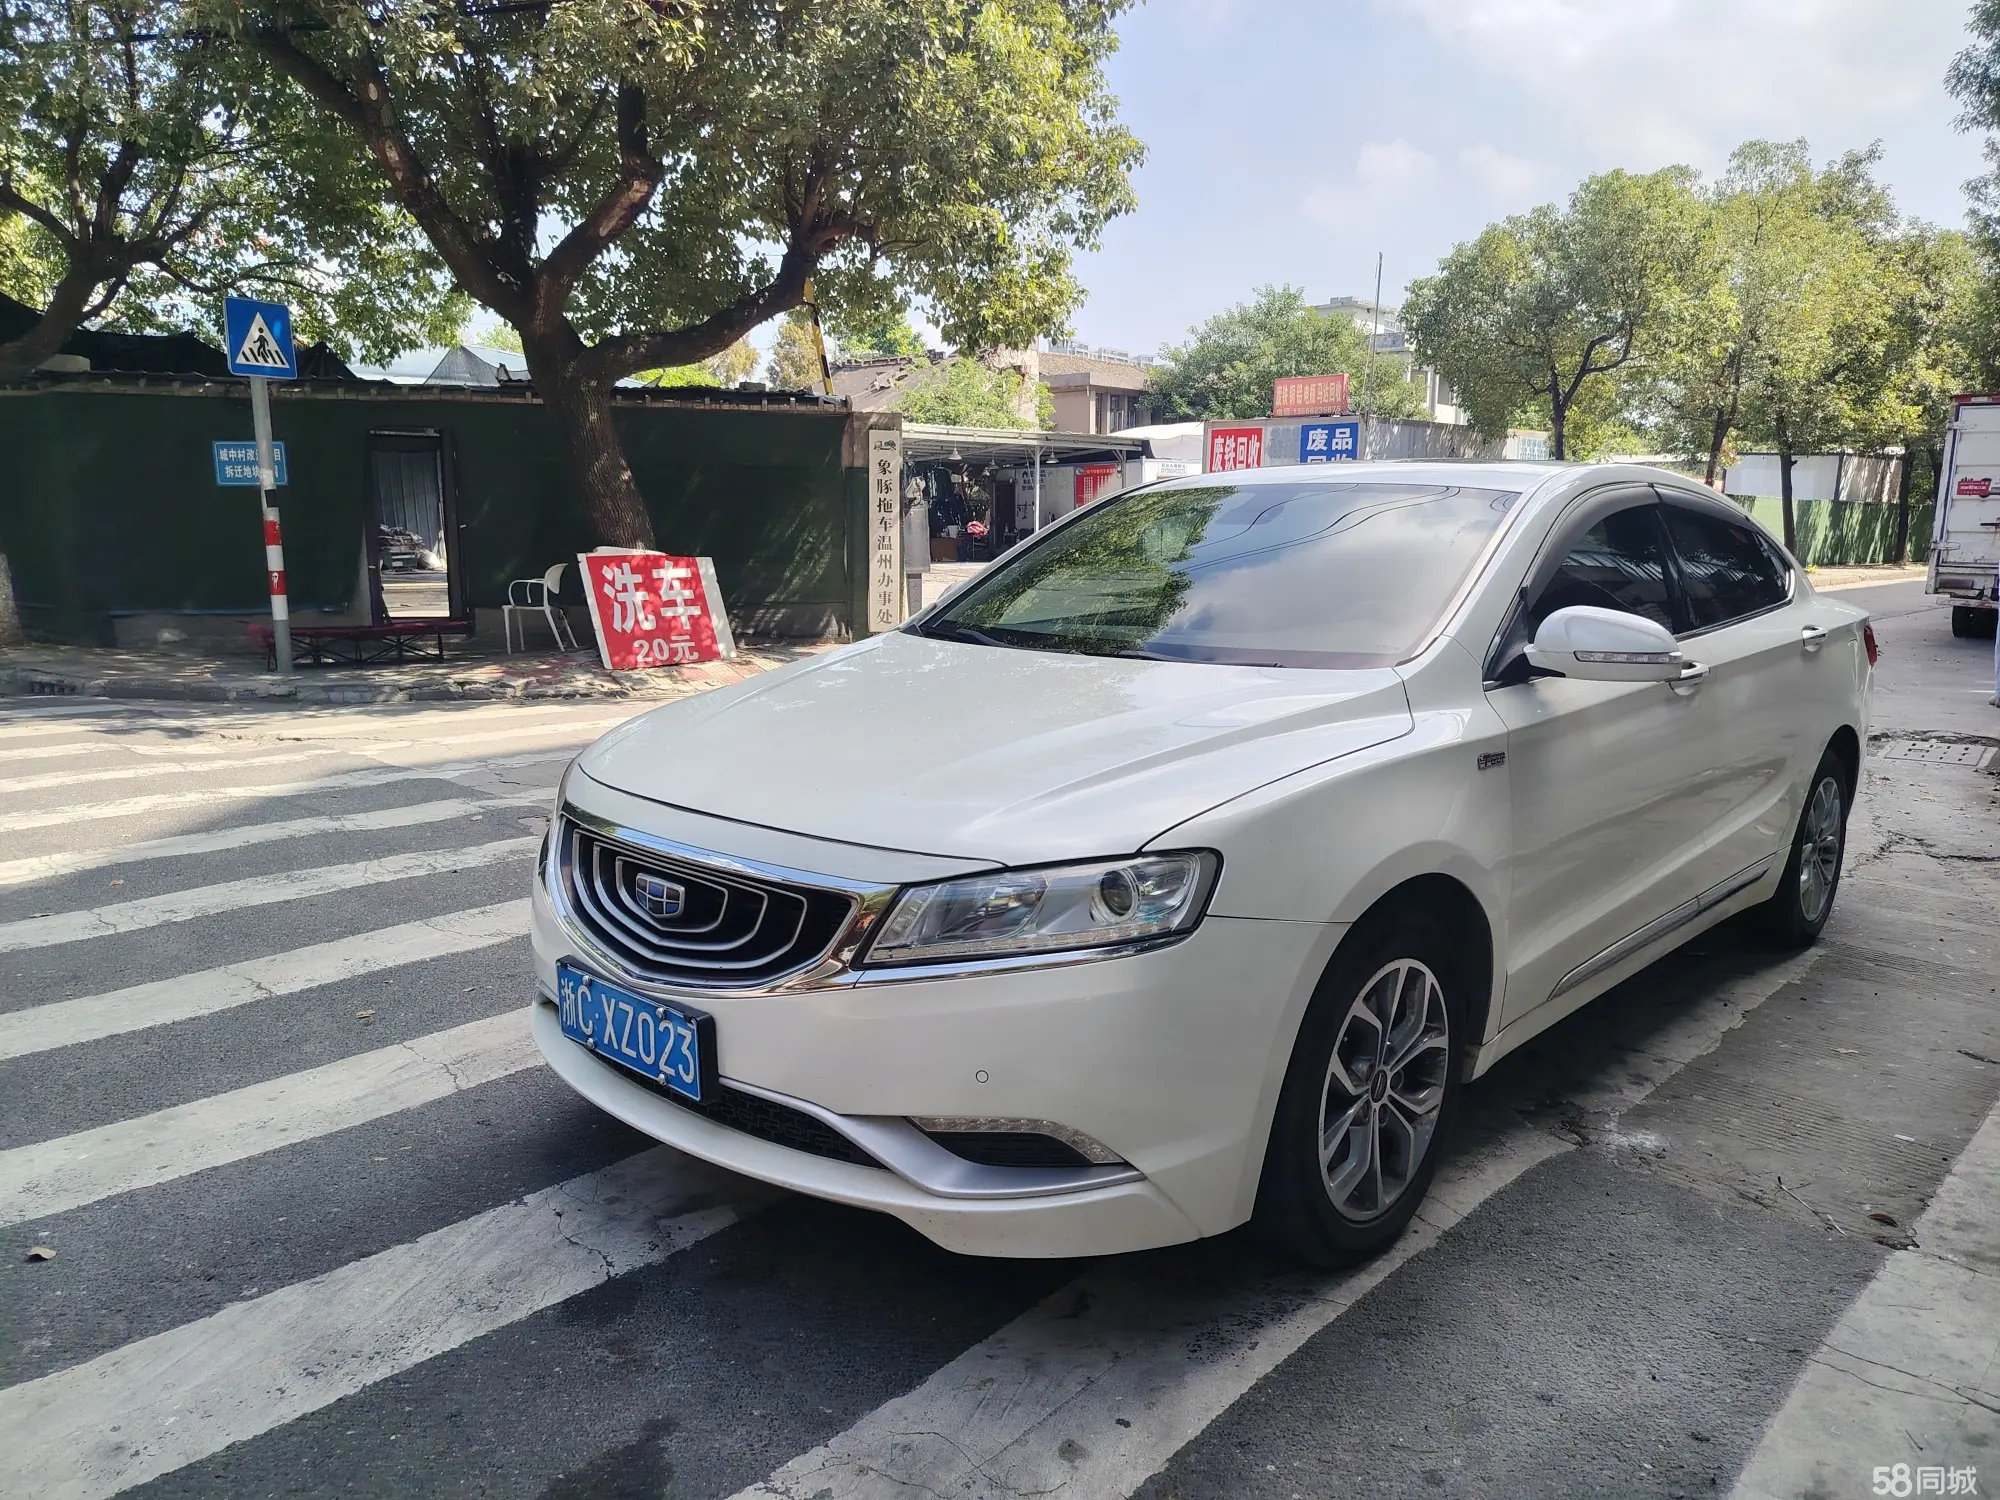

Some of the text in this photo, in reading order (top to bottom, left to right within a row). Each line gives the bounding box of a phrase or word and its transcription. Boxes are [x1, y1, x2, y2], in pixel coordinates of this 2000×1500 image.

[1211, 433, 1261, 472] 废铁回收
[1306, 427, 1352, 451] 废品
[219, 447, 281, 462] 城中村改目
[224, 464, 279, 478] 拆迁地块
[876, 458, 894, 625] 象豚拖车温州办事处
[601, 560, 702, 634] 洗车
[633, 634, 699, 662] 20元
